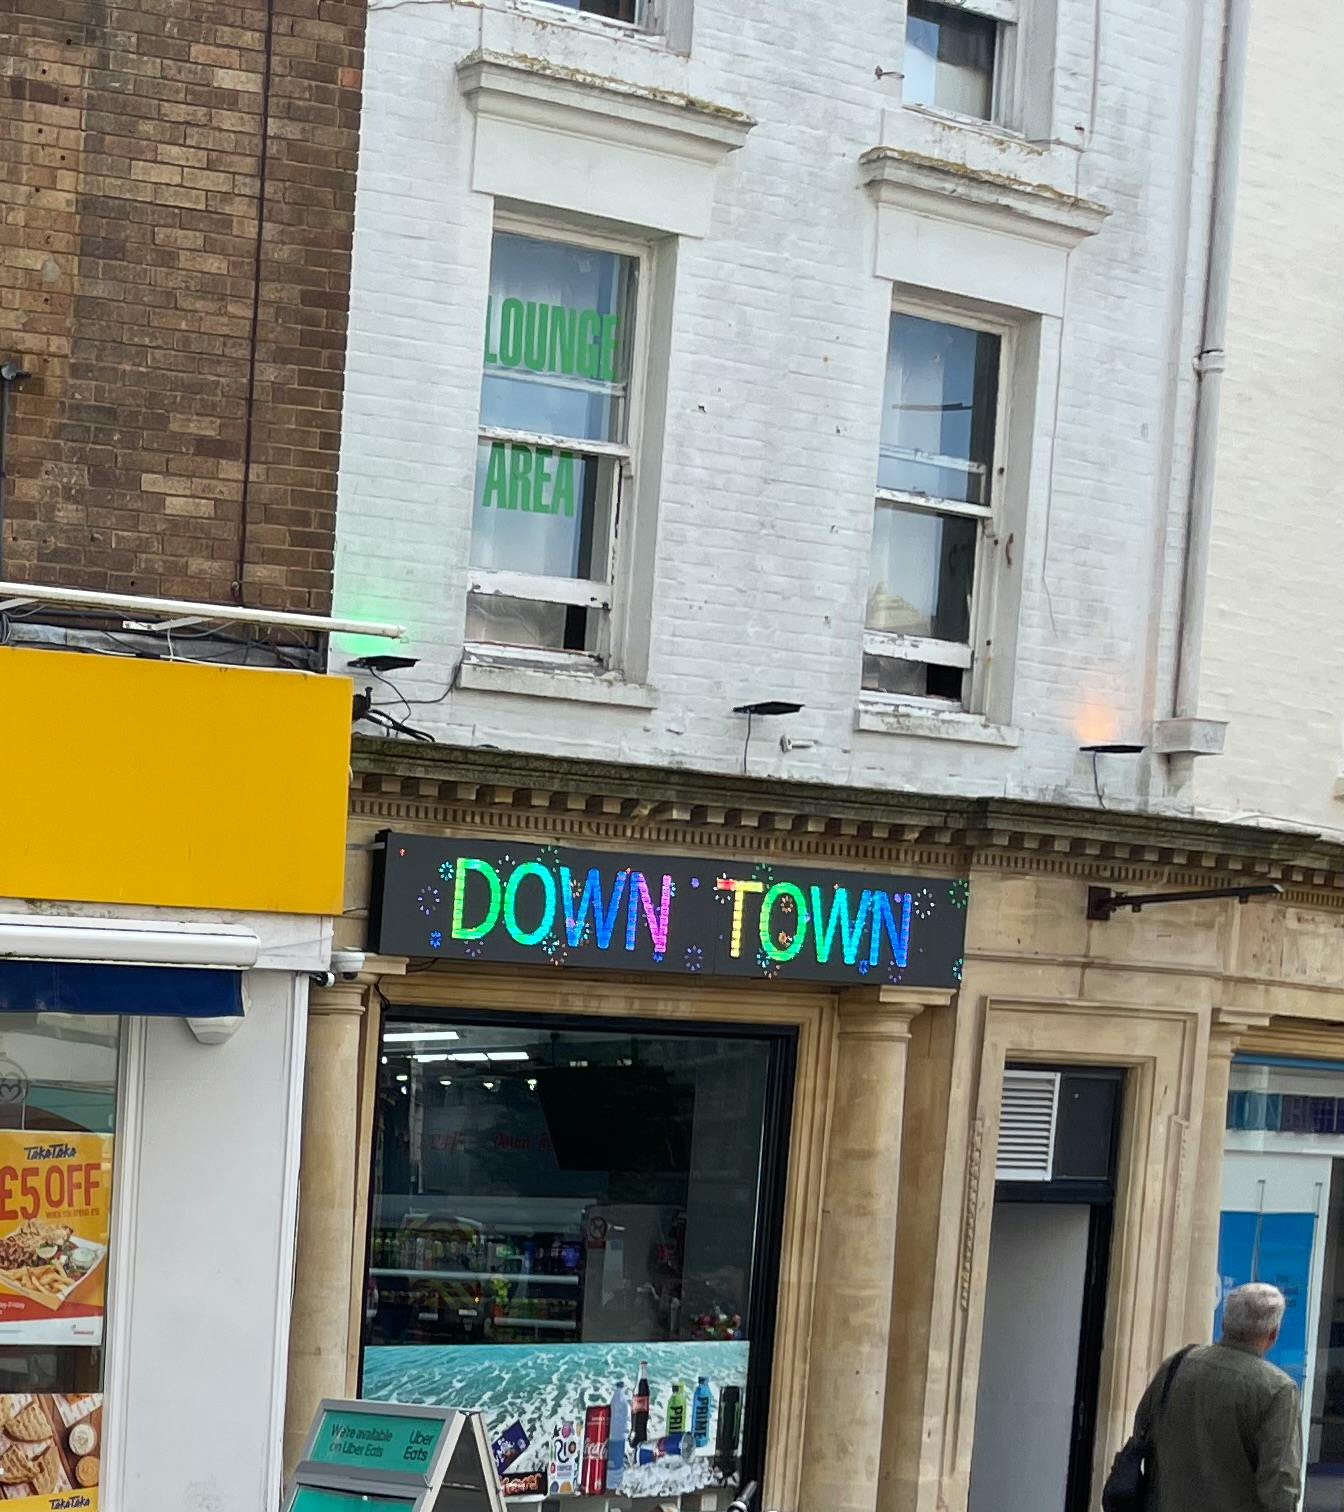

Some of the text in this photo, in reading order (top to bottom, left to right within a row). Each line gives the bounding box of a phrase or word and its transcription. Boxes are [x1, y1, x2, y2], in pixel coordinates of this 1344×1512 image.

[484, 295, 621, 382] LOUNGE
[481, 441, 576, 518] AREA
[451, 856, 913, 968] DOWN TOWN
[44, 1162, 102, 1209] OFF
[342, 1441, 364, 1456] Uber
[364, 1443, 385, 1458] Eats
[402, 1445, 429, 1462] Eats
[408, 1428, 435, 1446] Uber
